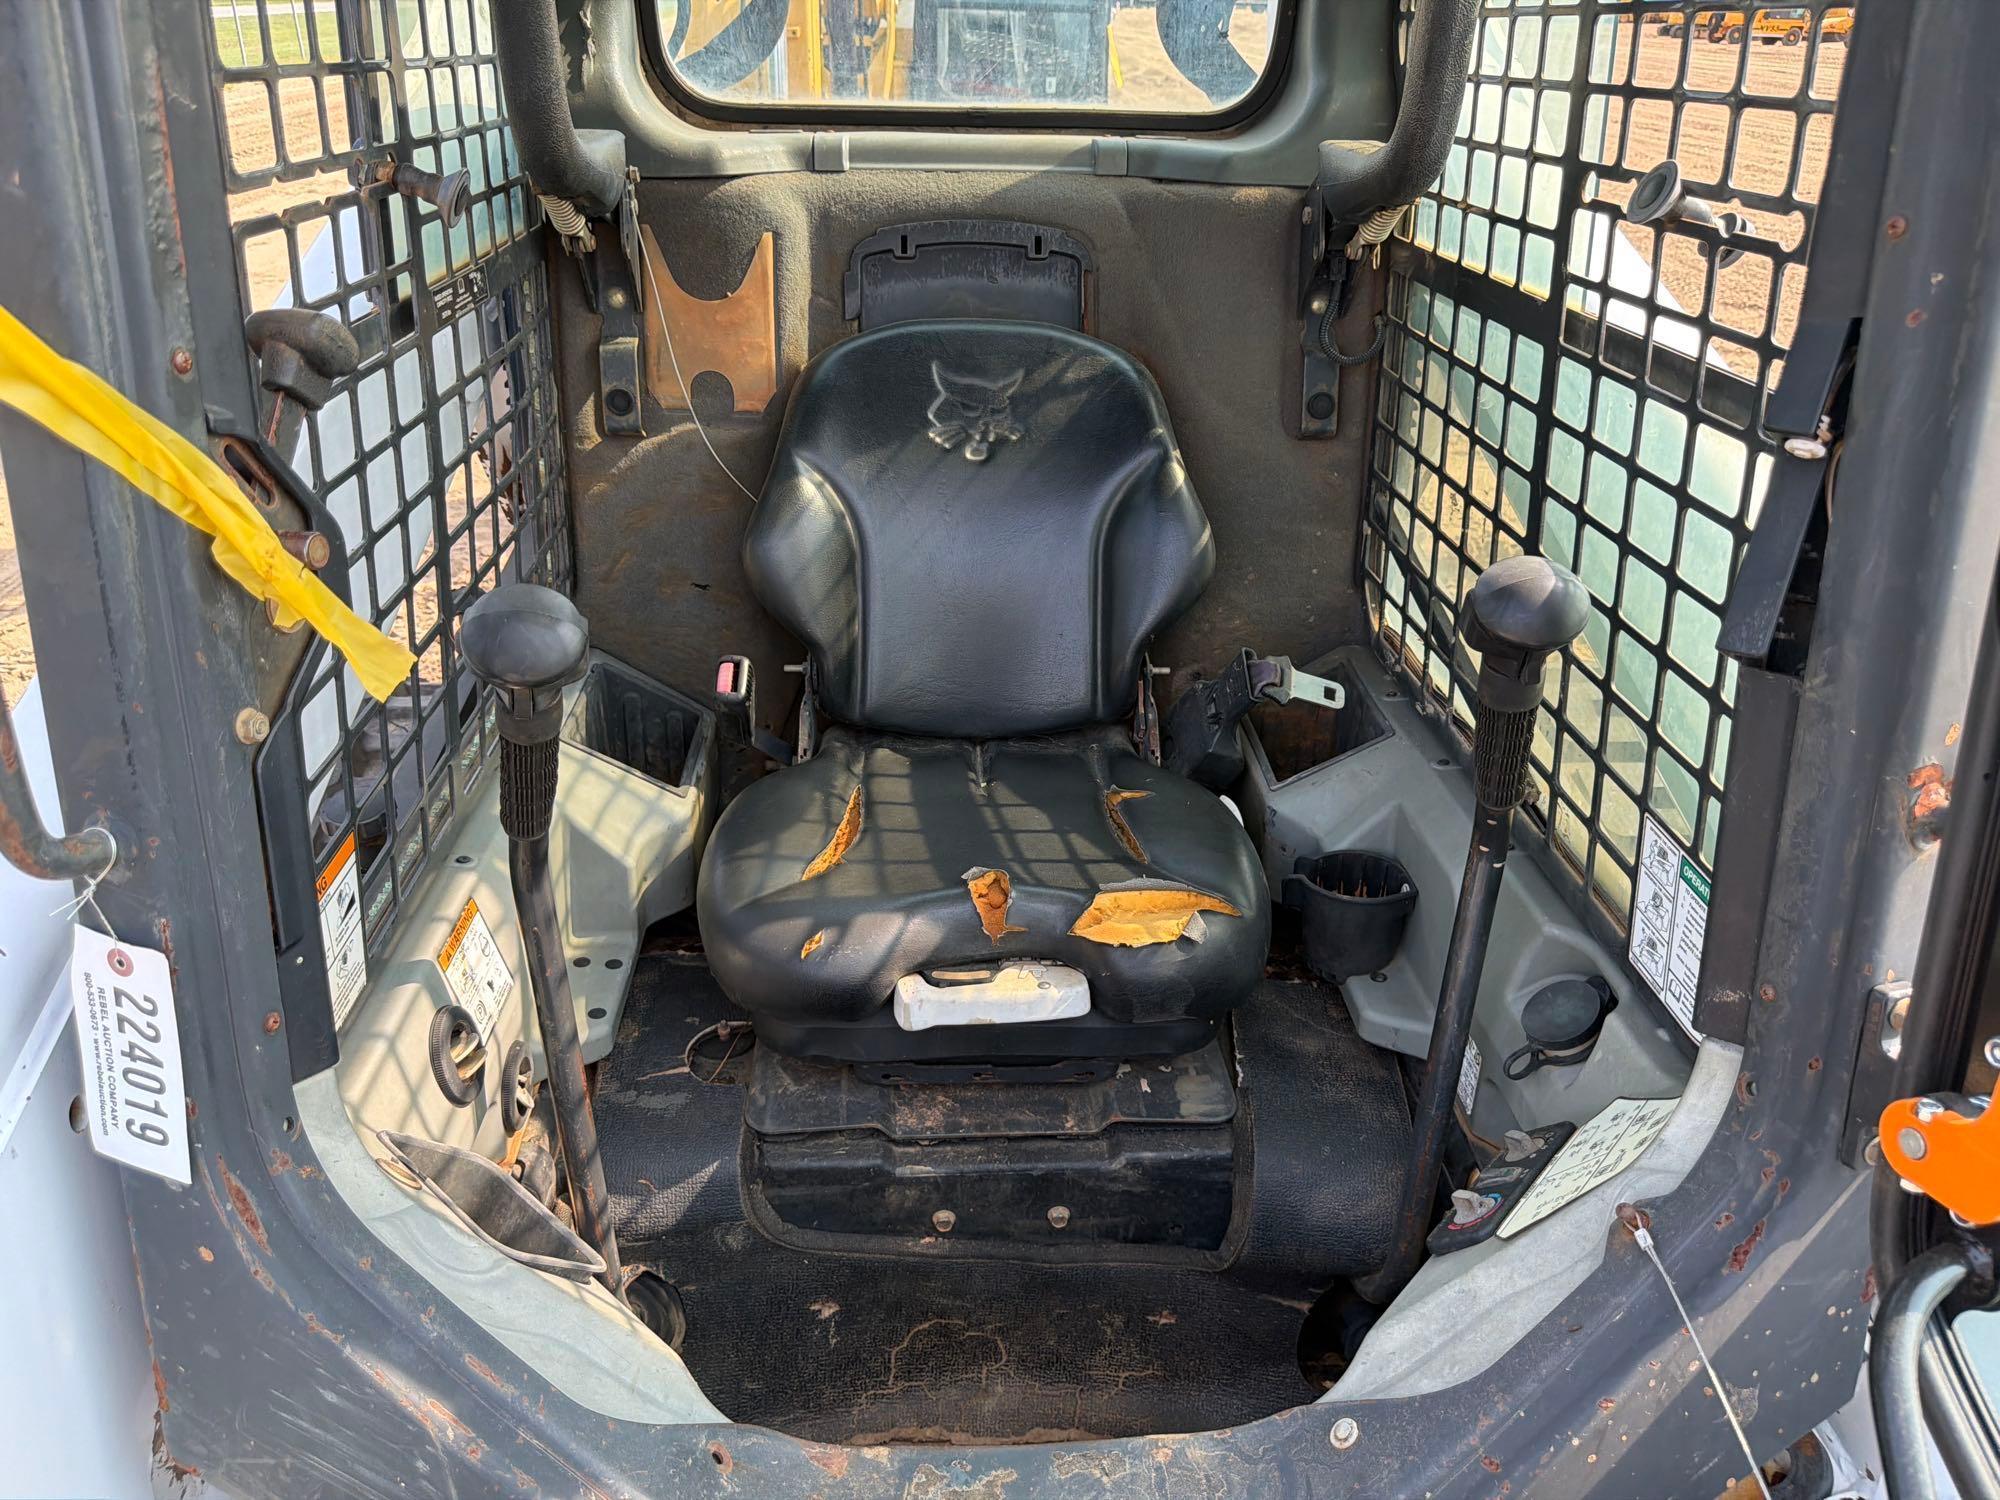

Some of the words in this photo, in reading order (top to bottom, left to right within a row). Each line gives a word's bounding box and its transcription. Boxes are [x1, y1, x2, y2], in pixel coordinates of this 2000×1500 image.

[1683, 866, 1710, 900] OPERATI
[450, 908, 474, 951] WARNING
[97, 986, 109, 1022] REBEL
[84, 971, 99, 1031] 800-533-0673
[93, 1037, 109, 1136] www.rebelauction.com
[102, 1023, 115, 1073] AUCTION
[113, 986, 170, 1147] 224019
[107, 1075, 119, 1130] COMPANY
